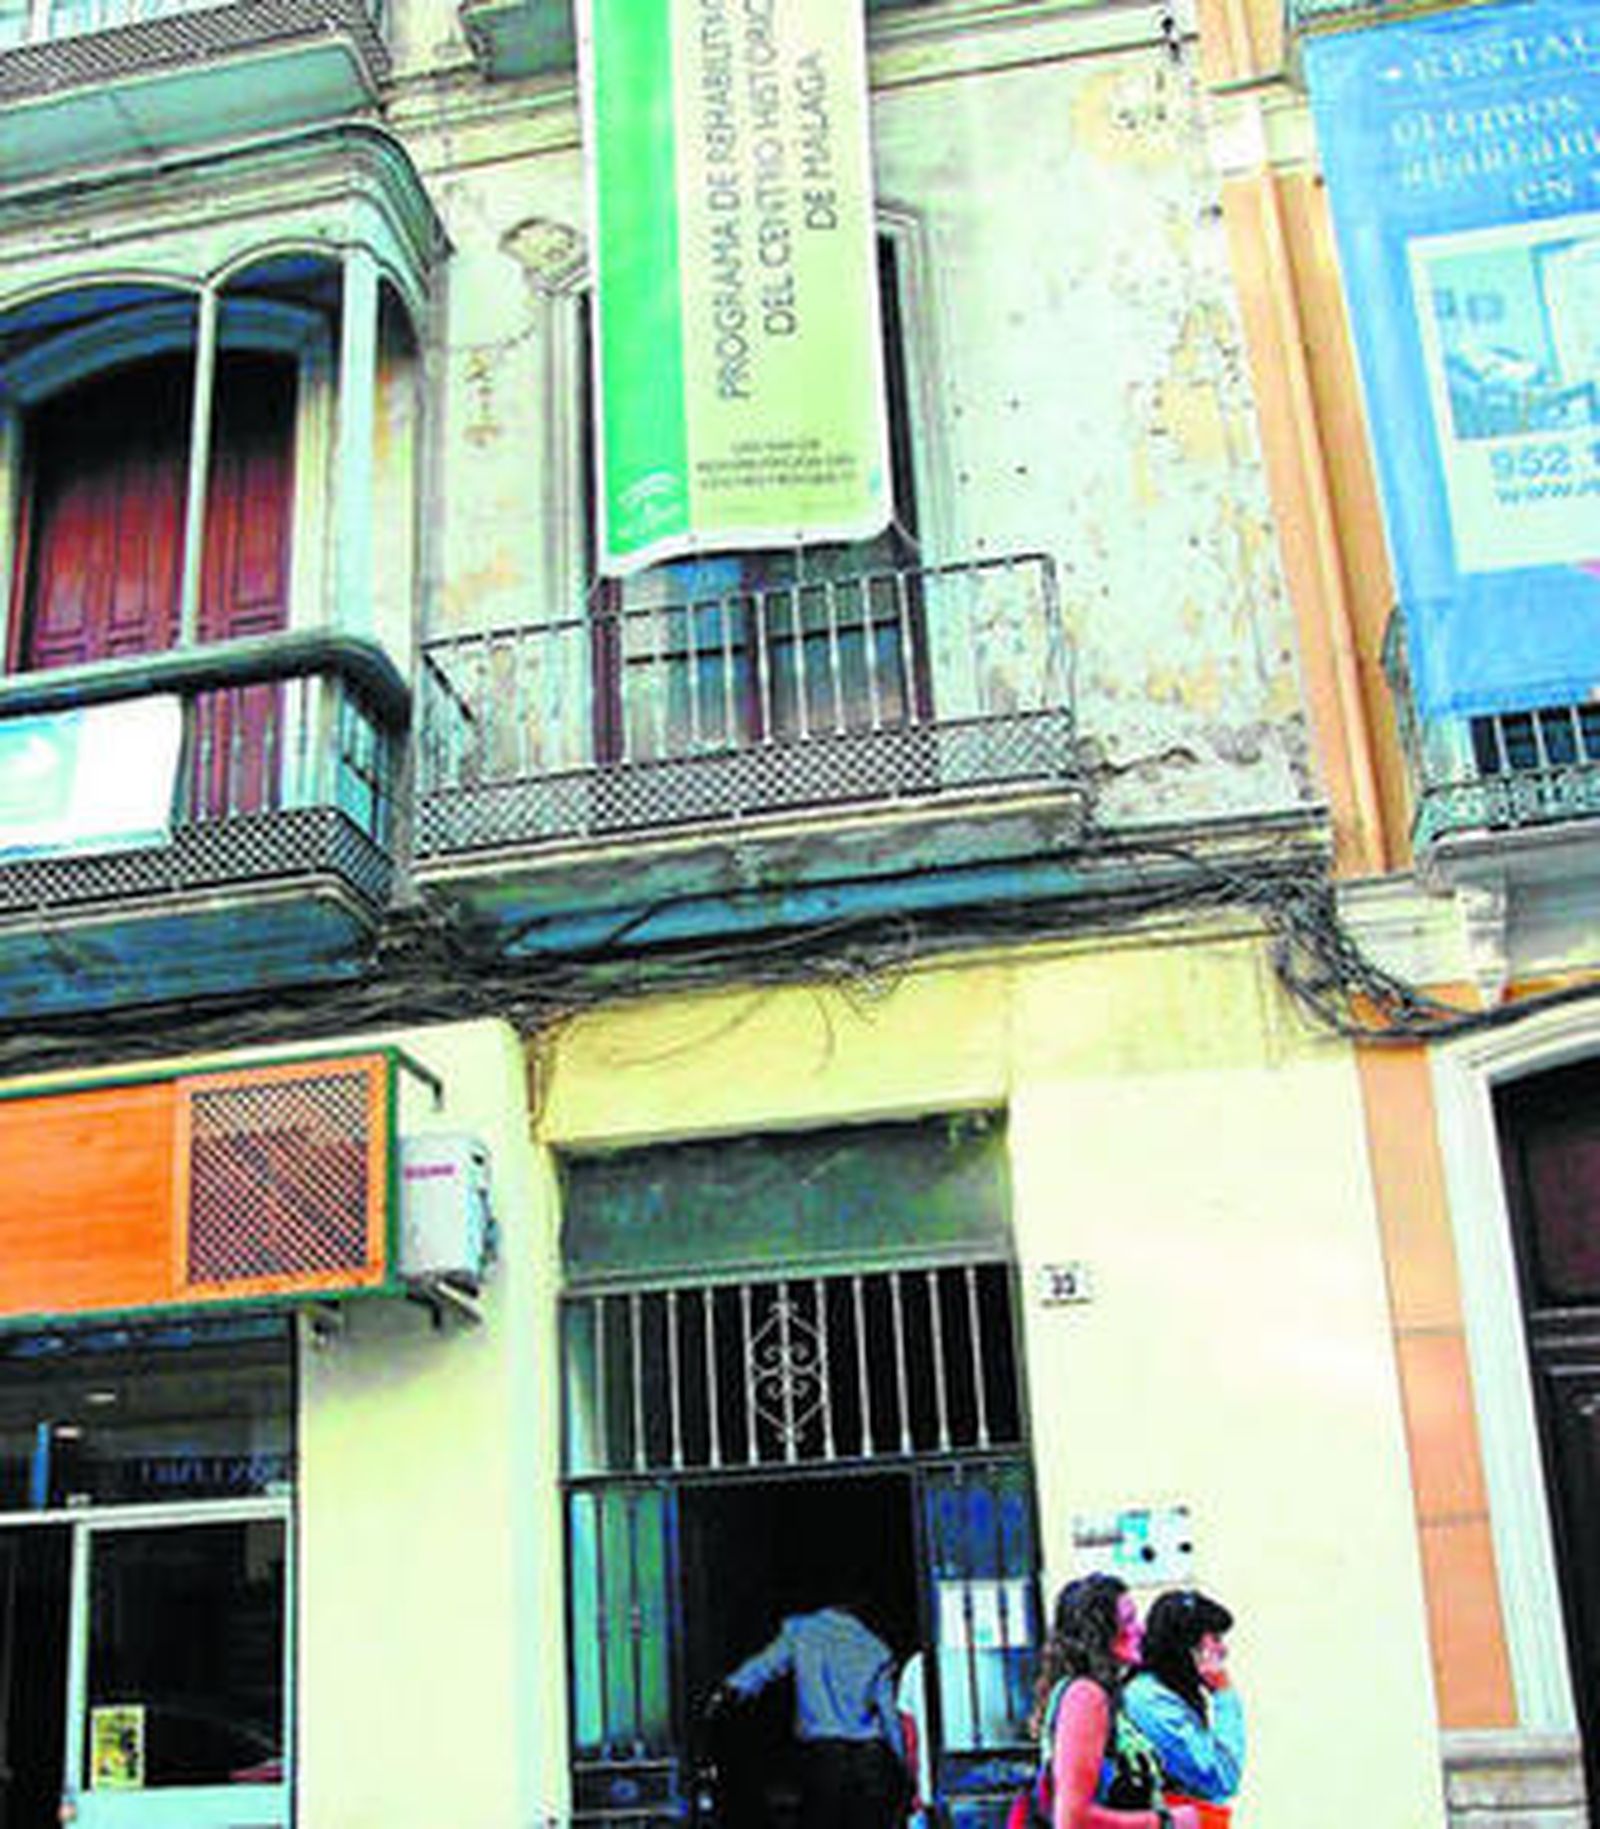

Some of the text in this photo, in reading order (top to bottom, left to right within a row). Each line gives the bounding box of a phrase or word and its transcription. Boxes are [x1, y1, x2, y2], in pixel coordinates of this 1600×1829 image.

[706, 170, 741, 211] DE
[802, 189, 838, 231] DE
[762, 271, 797, 336] DEL
